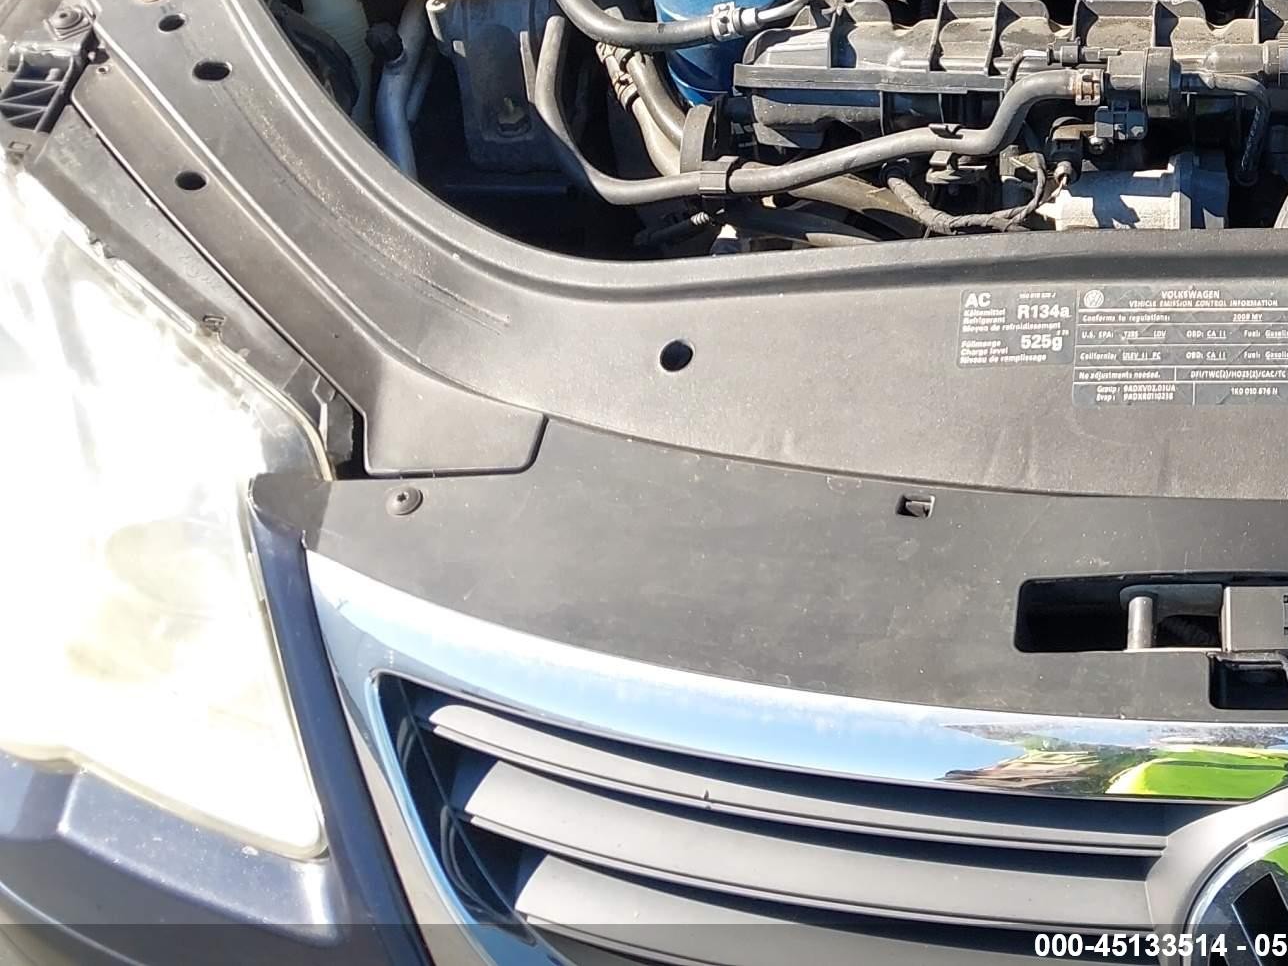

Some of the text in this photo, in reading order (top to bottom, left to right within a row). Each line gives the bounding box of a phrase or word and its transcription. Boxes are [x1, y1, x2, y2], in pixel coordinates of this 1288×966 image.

[1161, 290, 1220, 299] VOLKSWAGEN
[965, 293, 991, 307] AC
[1129, 299, 1278, 307] VEHICLE EMISSION CONTROL INFORMATION
[1017, 304, 1070, 319] R134a
[963, 316, 1006, 325] Refrigerant
[1119, 314, 1127, 322] to
[1252, 314, 1263, 322] MY
[962, 325, 988, 333] Moyen
[1002, 322, 1061, 332] refroidissement
[1082, 330, 1096, 339] U.S.
[1153, 330, 1167, 339] LDV
[1186, 330, 1204, 338] OBD:
[1206, 330, 1216, 338] CA
[1021, 334, 1063, 351] 525g
[990, 347, 1008, 355] level
[1152, 351, 1161, 360] PC
[1186, 351, 1204, 359] OBD:
[1206, 351, 1216, 359] CA
[1243, 351, 1261, 359] Fuel:
[989, 355, 999, 363] de
[1079, 371, 1161, 380] No adjustments needed.
